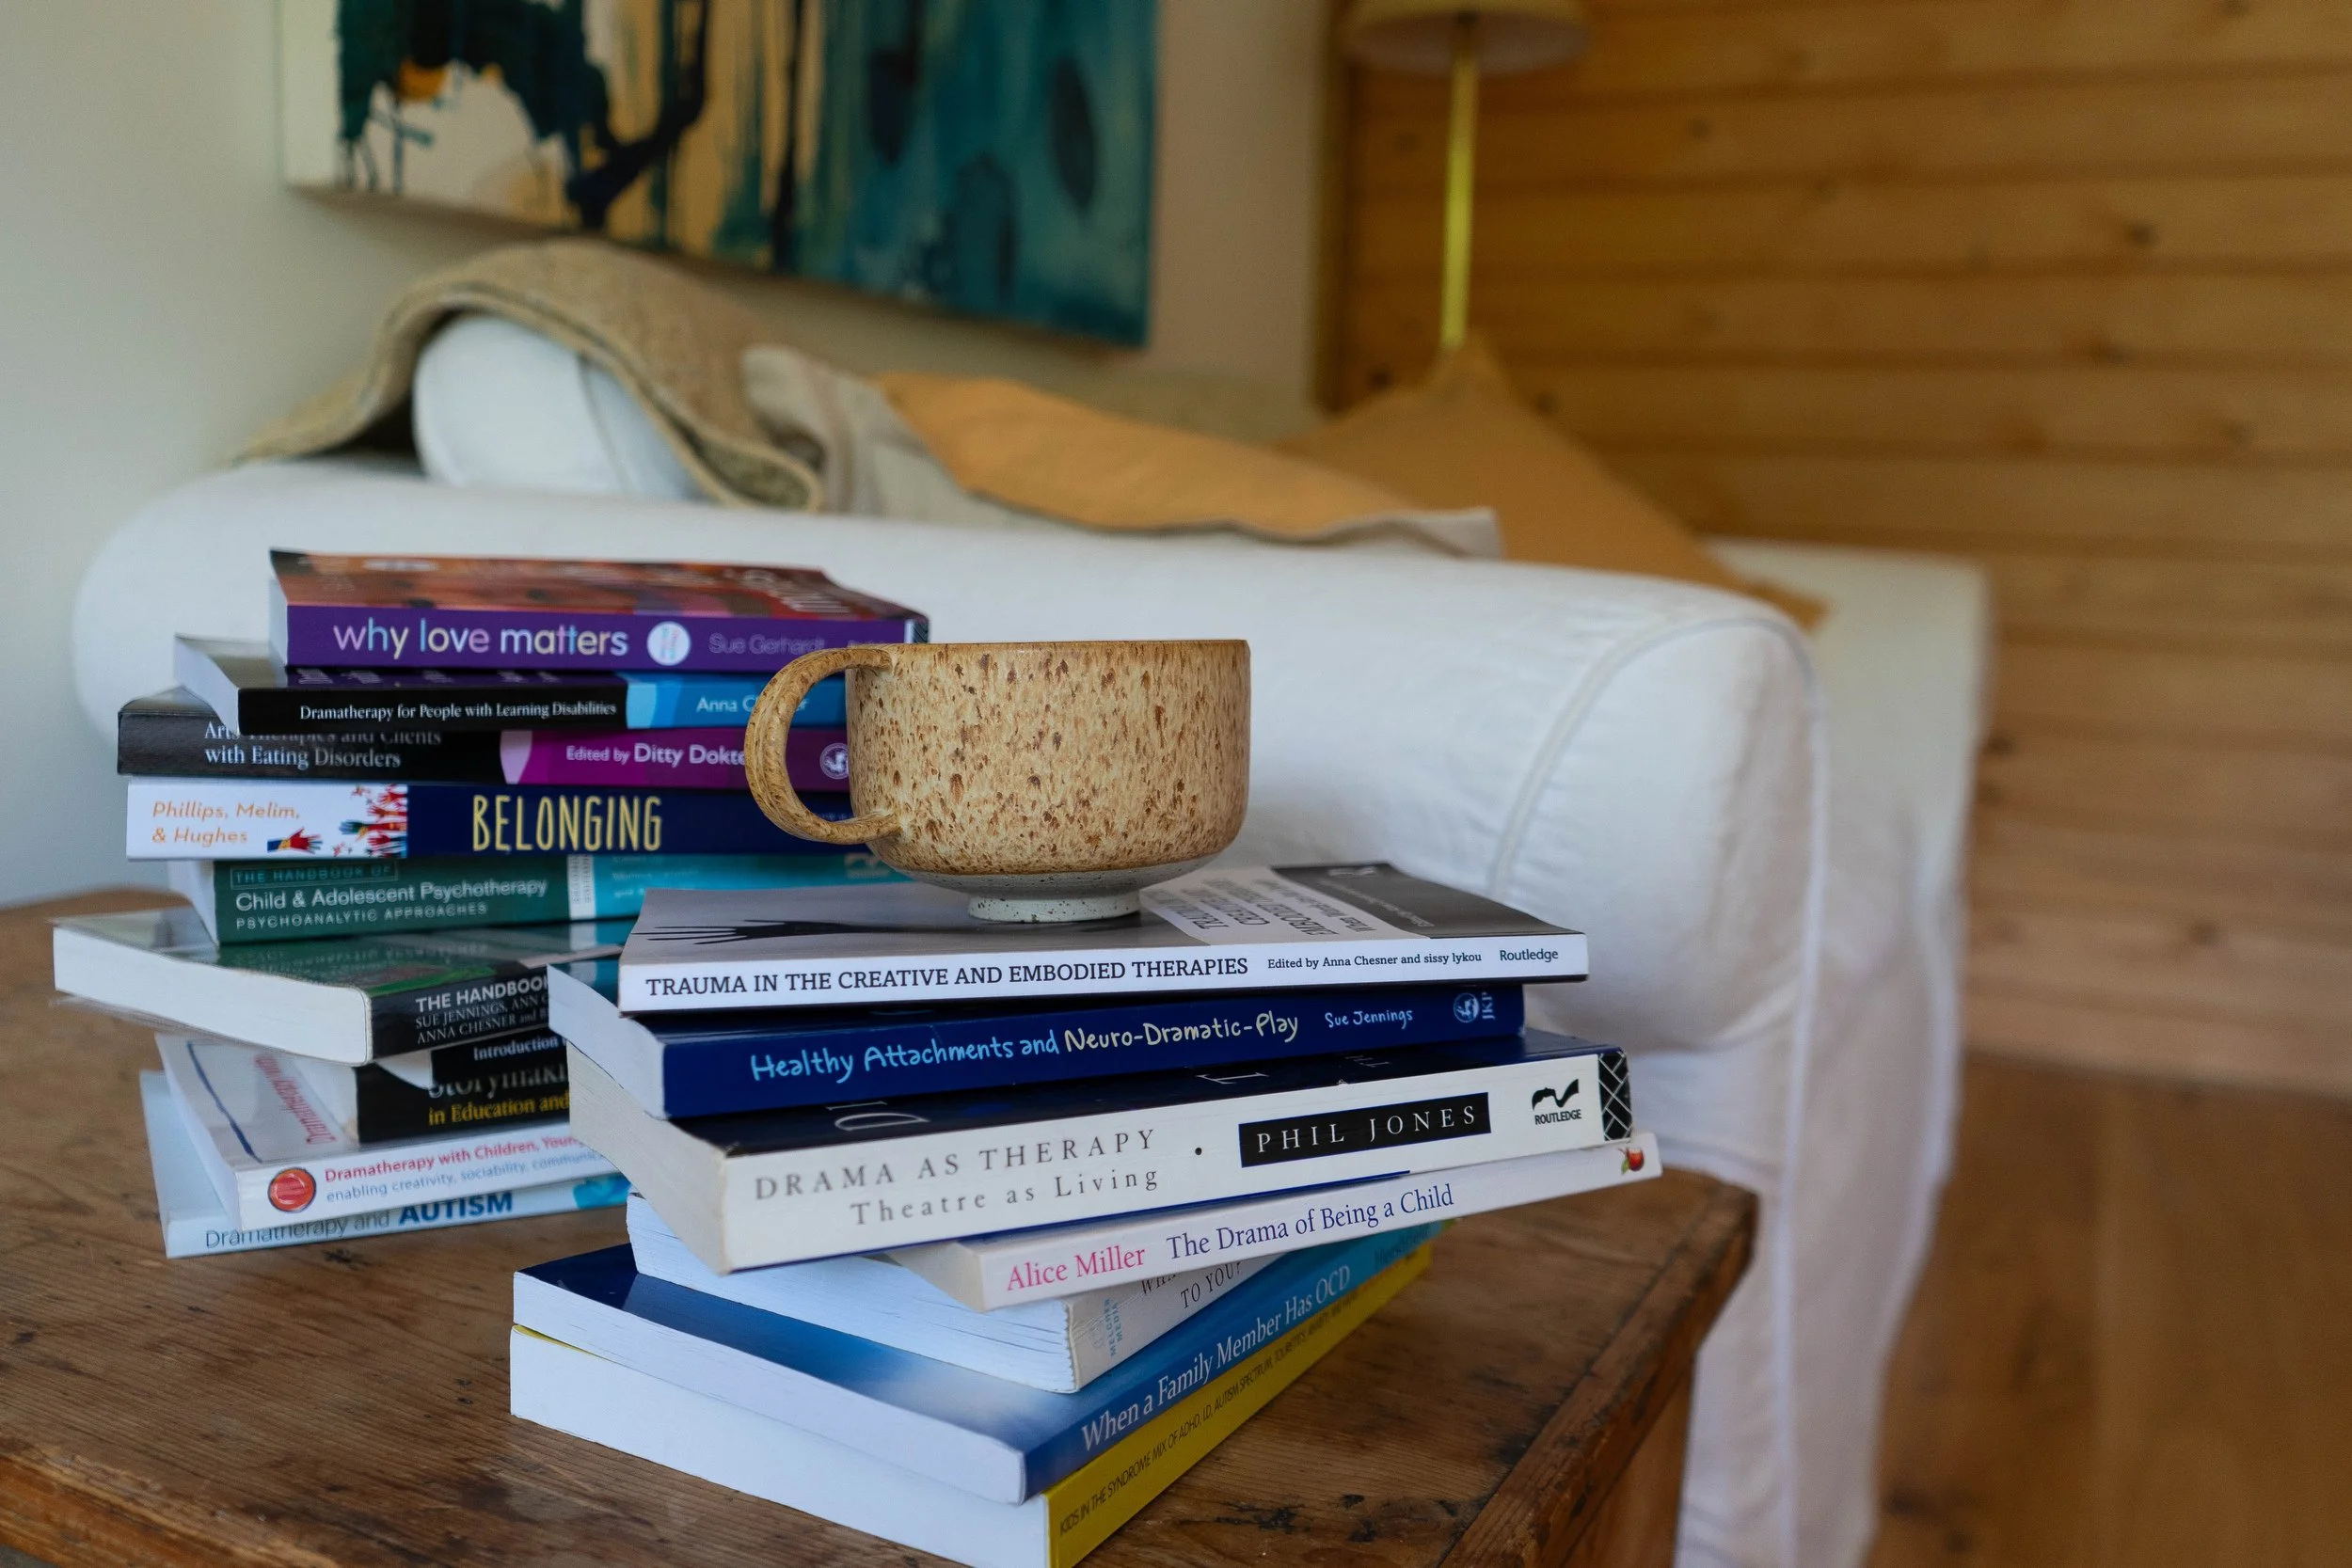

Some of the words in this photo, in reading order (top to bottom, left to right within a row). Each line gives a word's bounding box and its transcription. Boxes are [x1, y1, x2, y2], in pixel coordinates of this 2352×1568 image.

[333, 616, 409, 659] why
[420, 617, 490, 654] love
[500, 624, 629, 657] matters
[707, 632, 745, 655] Sue
[749, 633, 826, 656] Gerhardt
[300, 704, 393, 722] Dramatherapy
[397, 703, 416, 719] for
[420, 703, 462, 721] People
[465, 703, 492, 717] with
[497, 702, 548, 720] Learning
[552, 701, 617, 716] Disabilities
[696, 696, 738, 713] Anna
[204, 745, 245, 765] with
[251, 745, 309, 771] Eating
[314, 746, 402, 768] Disorders
[566, 744, 611, 762] Edited
[612, 746, 631, 766] by
[633, 741, 684, 768] Ditty
[152, 800, 228, 822] Phillips,
[235, 800, 300, 820] Melim,
[472, 794, 663, 851] BELONGING
[151, 828, 167, 844] &
[173, 827, 247, 847] Hughes
[235, 869, 265, 884] THE
[273, 866, 363, 883] HANDBOOK
[235, 891, 286, 911] Child
[292, 891, 308, 909] &
[311, 885, 415, 908] Adolescent
[421, 879, 548, 903] Psychotherapy
[235, 910, 377, 930] PSYCHOANALYTIC
[384, 902, 488, 921] APPROACHES
[1267, 957, 1303, 970] Edited
[1305, 956, 1320, 970] by
[1322, 955, 1352, 968] Anna
[1354, 953, 1398, 967] Chesner
[1401, 952, 1422, 965] and
[1423, 951, 1449, 967] sissy
[1452, 950, 1483, 964] lykou
[1499, 947, 1559, 964] Routledge
[645, 975, 747, 996] TRAUMA
[754, 974, 778, 992] IN
[785, 973, 832, 991] THE
[838, 968, 949, 990] CREATIVE
[954, 966, 1003, 985] AND
[1009, 961, 1126, 983] EMBODIED
[1132, 958, 1248, 979] THERAPIES
[415, 991, 452, 1013] THE
[415, 1013, 441, 1029] SUE
[443, 1001, 509, 1025] JENNINGS,
[512, 993, 539, 1011] ANN
[1481, 991, 1496, 1021] JKP
[417, 1026, 456, 1045] ANNA
[459, 1013, 516, 1036] CHESNER
[1324, 1012, 1348, 1029] Sue
[1352, 1008, 1414, 1030] Jennings
[473, 1036, 559, 1062] Introduction
[750, 1048, 853, 1084] Healthy
[864, 1037, 1013, 1071] Attachments
[1020, 1030, 1059, 1056] and
[1064, 1010, 1298, 1053] Neuro-Dramatic-Play
[428, 1106, 446, 1127] in
[451, 1097, 535, 1123] Education
[539, 1089, 570, 1111] and
[1534, 1108, 1582, 1126] ROUTLEDGE
[1257, 1123, 1345, 1153] PHIL
[1369, 1105, 1475, 1143] JONES
[324, 1155, 435, 1183] Dramatherapy
[438, 1149, 470, 1165] with
[473, 1141, 540, 1161] Children,
[755, 1164, 895, 1201] DRAMA
[917, 1152, 960, 1180] AS
[978, 1128, 1155, 1171] THERAPY
[326, 1181, 388, 1204] enabling
[391, 1172, 457, 1193] creativity,
[460, 1164, 527, 1183] sociability,
[850, 1193, 986, 1226] Theatre
[1007, 1187, 1036, 1205] as
[1055, 1169, 1158, 1198] Living
[354, 1211, 389, 1231] and
[397, 1191, 514, 1227] AUTISM
[1166, 1231, 1211, 1260] The
[1216, 1221, 1289, 1251] Drama
[1295, 1208, 1316, 1235] of
[1320, 1203, 1378, 1230] Being
[1383, 1201, 1394, 1218] a
[1400, 1183, 1455, 1214] Child
[1007, 1261, 1069, 1291] Alice
[1074, 1244, 1146, 1278] Miller
[1180, 1282, 1200, 1309] TO
[1081, 1402, 1139, 1452] When
[1143, 1394, 1153, 1415] a
[1158, 1352, 1215, 1408] Family
[1216, 1312, 1282, 1370] Member
[1284, 1294, 1313, 1326] Has
[1315, 1264, 1351, 1306] OCD
[1059, 1508, 1080, 1537] KIDS
[1081, 1502, 1090, 1520] IN
[1090, 1486, 1107, 1512] THE
[1106, 1452, 1152, 1499] SYNDROME
[1152, 1443, 1168, 1465] MIX
[1168, 1433, 1178, 1452] OF
[1177, 1413, 1203, 1441] ADHD,
[1202, 1404, 1214, 1423] LD,
[1214, 1385, 1240, 1412] AUTISM
